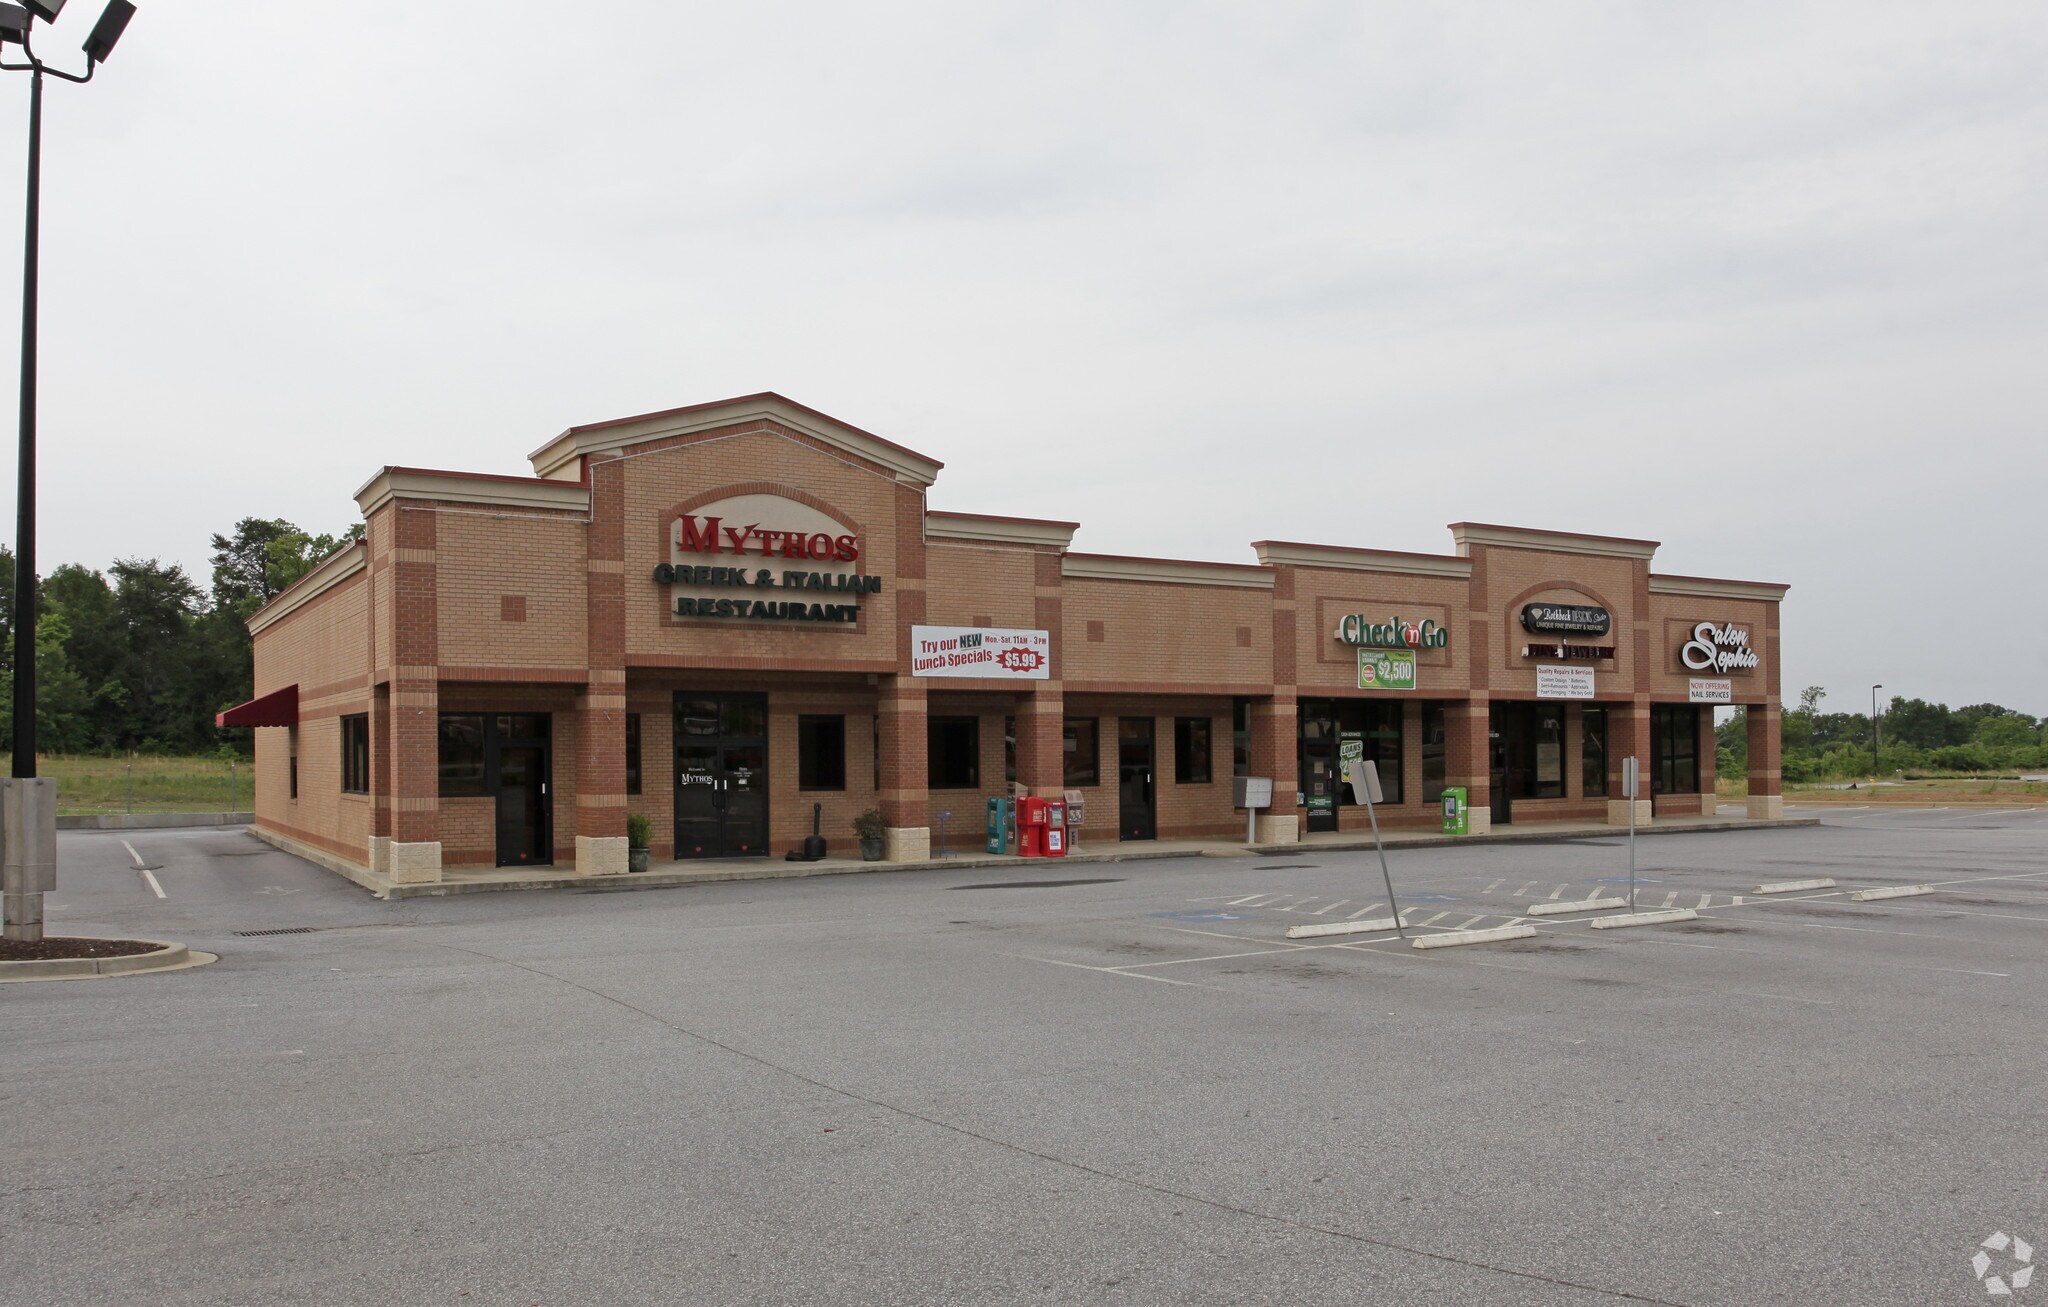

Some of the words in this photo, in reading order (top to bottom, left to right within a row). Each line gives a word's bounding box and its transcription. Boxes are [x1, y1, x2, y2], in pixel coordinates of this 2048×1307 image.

[678, 514, 859, 562] MYTHOS
[654, 563, 748, 587] GREEK
[755, 569, 775, 589] &
[783, 571, 881, 593] ITALIAN
[677, 597, 861, 623] RESTAURANT
[1340, 613, 1406, 646] Check
[1419, 619, 1448, 648] Go
[1536, 621, 1554, 629] UNIQUE
[921, 640, 938, 653] Try
[940, 638, 958, 651] our
[960, 633, 982, 648] NEW
[914, 655, 946, 671] Lunch
[948, 650, 993, 666] Specials
[1004, 652, 1036, 667] $5.99
[1378, 661, 1411, 681] $2,500
[1342, 743, 1361, 754] LOANS
[682, 773, 713, 783] MYTHOS
